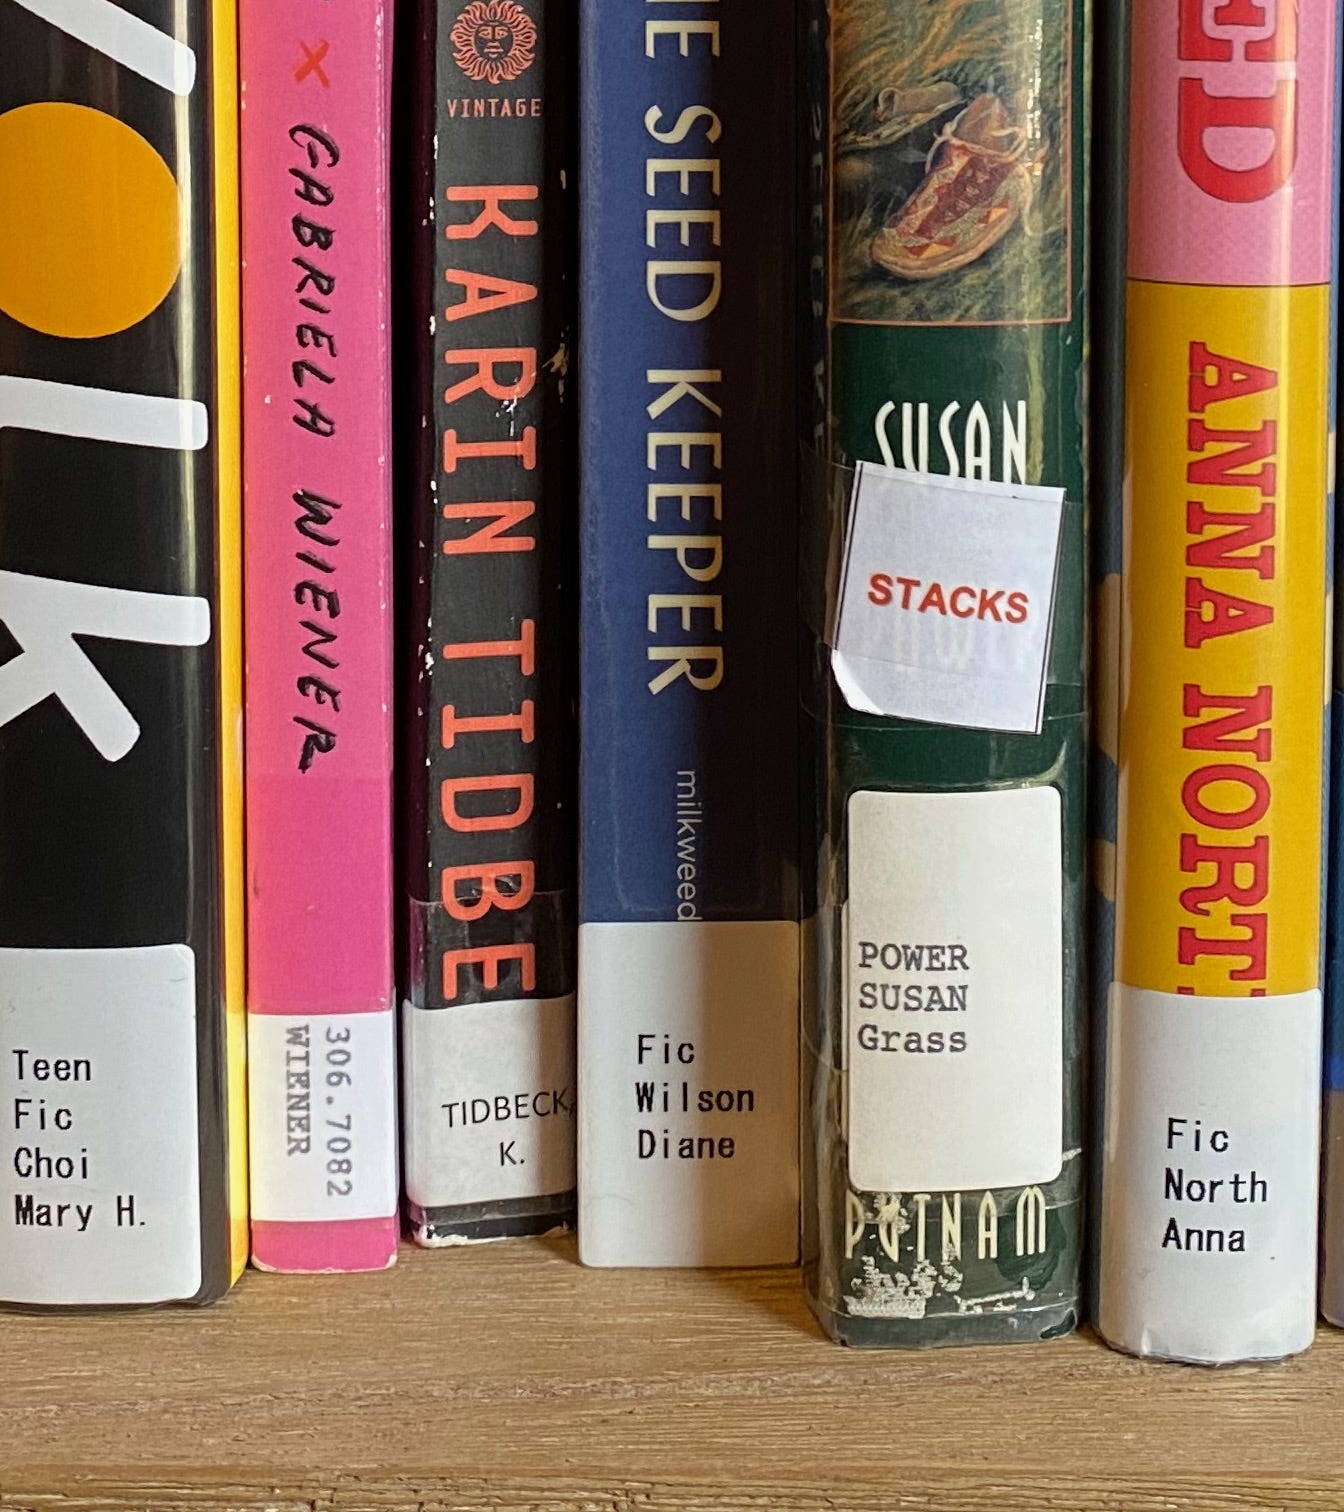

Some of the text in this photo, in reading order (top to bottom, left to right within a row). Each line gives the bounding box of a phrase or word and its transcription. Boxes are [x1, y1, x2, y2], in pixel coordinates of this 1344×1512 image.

[447, 97, 542, 120] VINTAGE
[645, 104, 723, 322] SEED
[442, 183, 539, 555] KARIN
[287, 123, 342, 773] GABRIELA WIENER
[874, 400, 1026, 485] SUSAN
[645, 369, 725, 696] KEEPER
[867, 573, 1029, 624] STACKS
[1178, 340, 1278, 997] ANNA NORT
[858, 942, 970, 971] POWER
[858, 984, 968, 1012] SUSAN
[636, 1034, 695, 1065] Fic
[858, 1024, 968, 1053] Grass
[12, 1049, 92, 1082] Teen
[285, 1024, 311, 1157] WIENER
[634, 1083, 755, 1113] Wilson
[14, 1098, 73, 1130] Fic
[325, 1026, 353, 1197] 306.7082
[636, 1129, 735, 1160] Diane
[1167, 1117, 1229, 1153] Fic
[13, 1147, 89, 1179] Choi
[499, 1141, 525, 1166] K.
[1164, 1168, 1268, 1203] North
[14, 1194, 146, 1232] Mary H.
[1162, 1218, 1246, 1253] Anna
